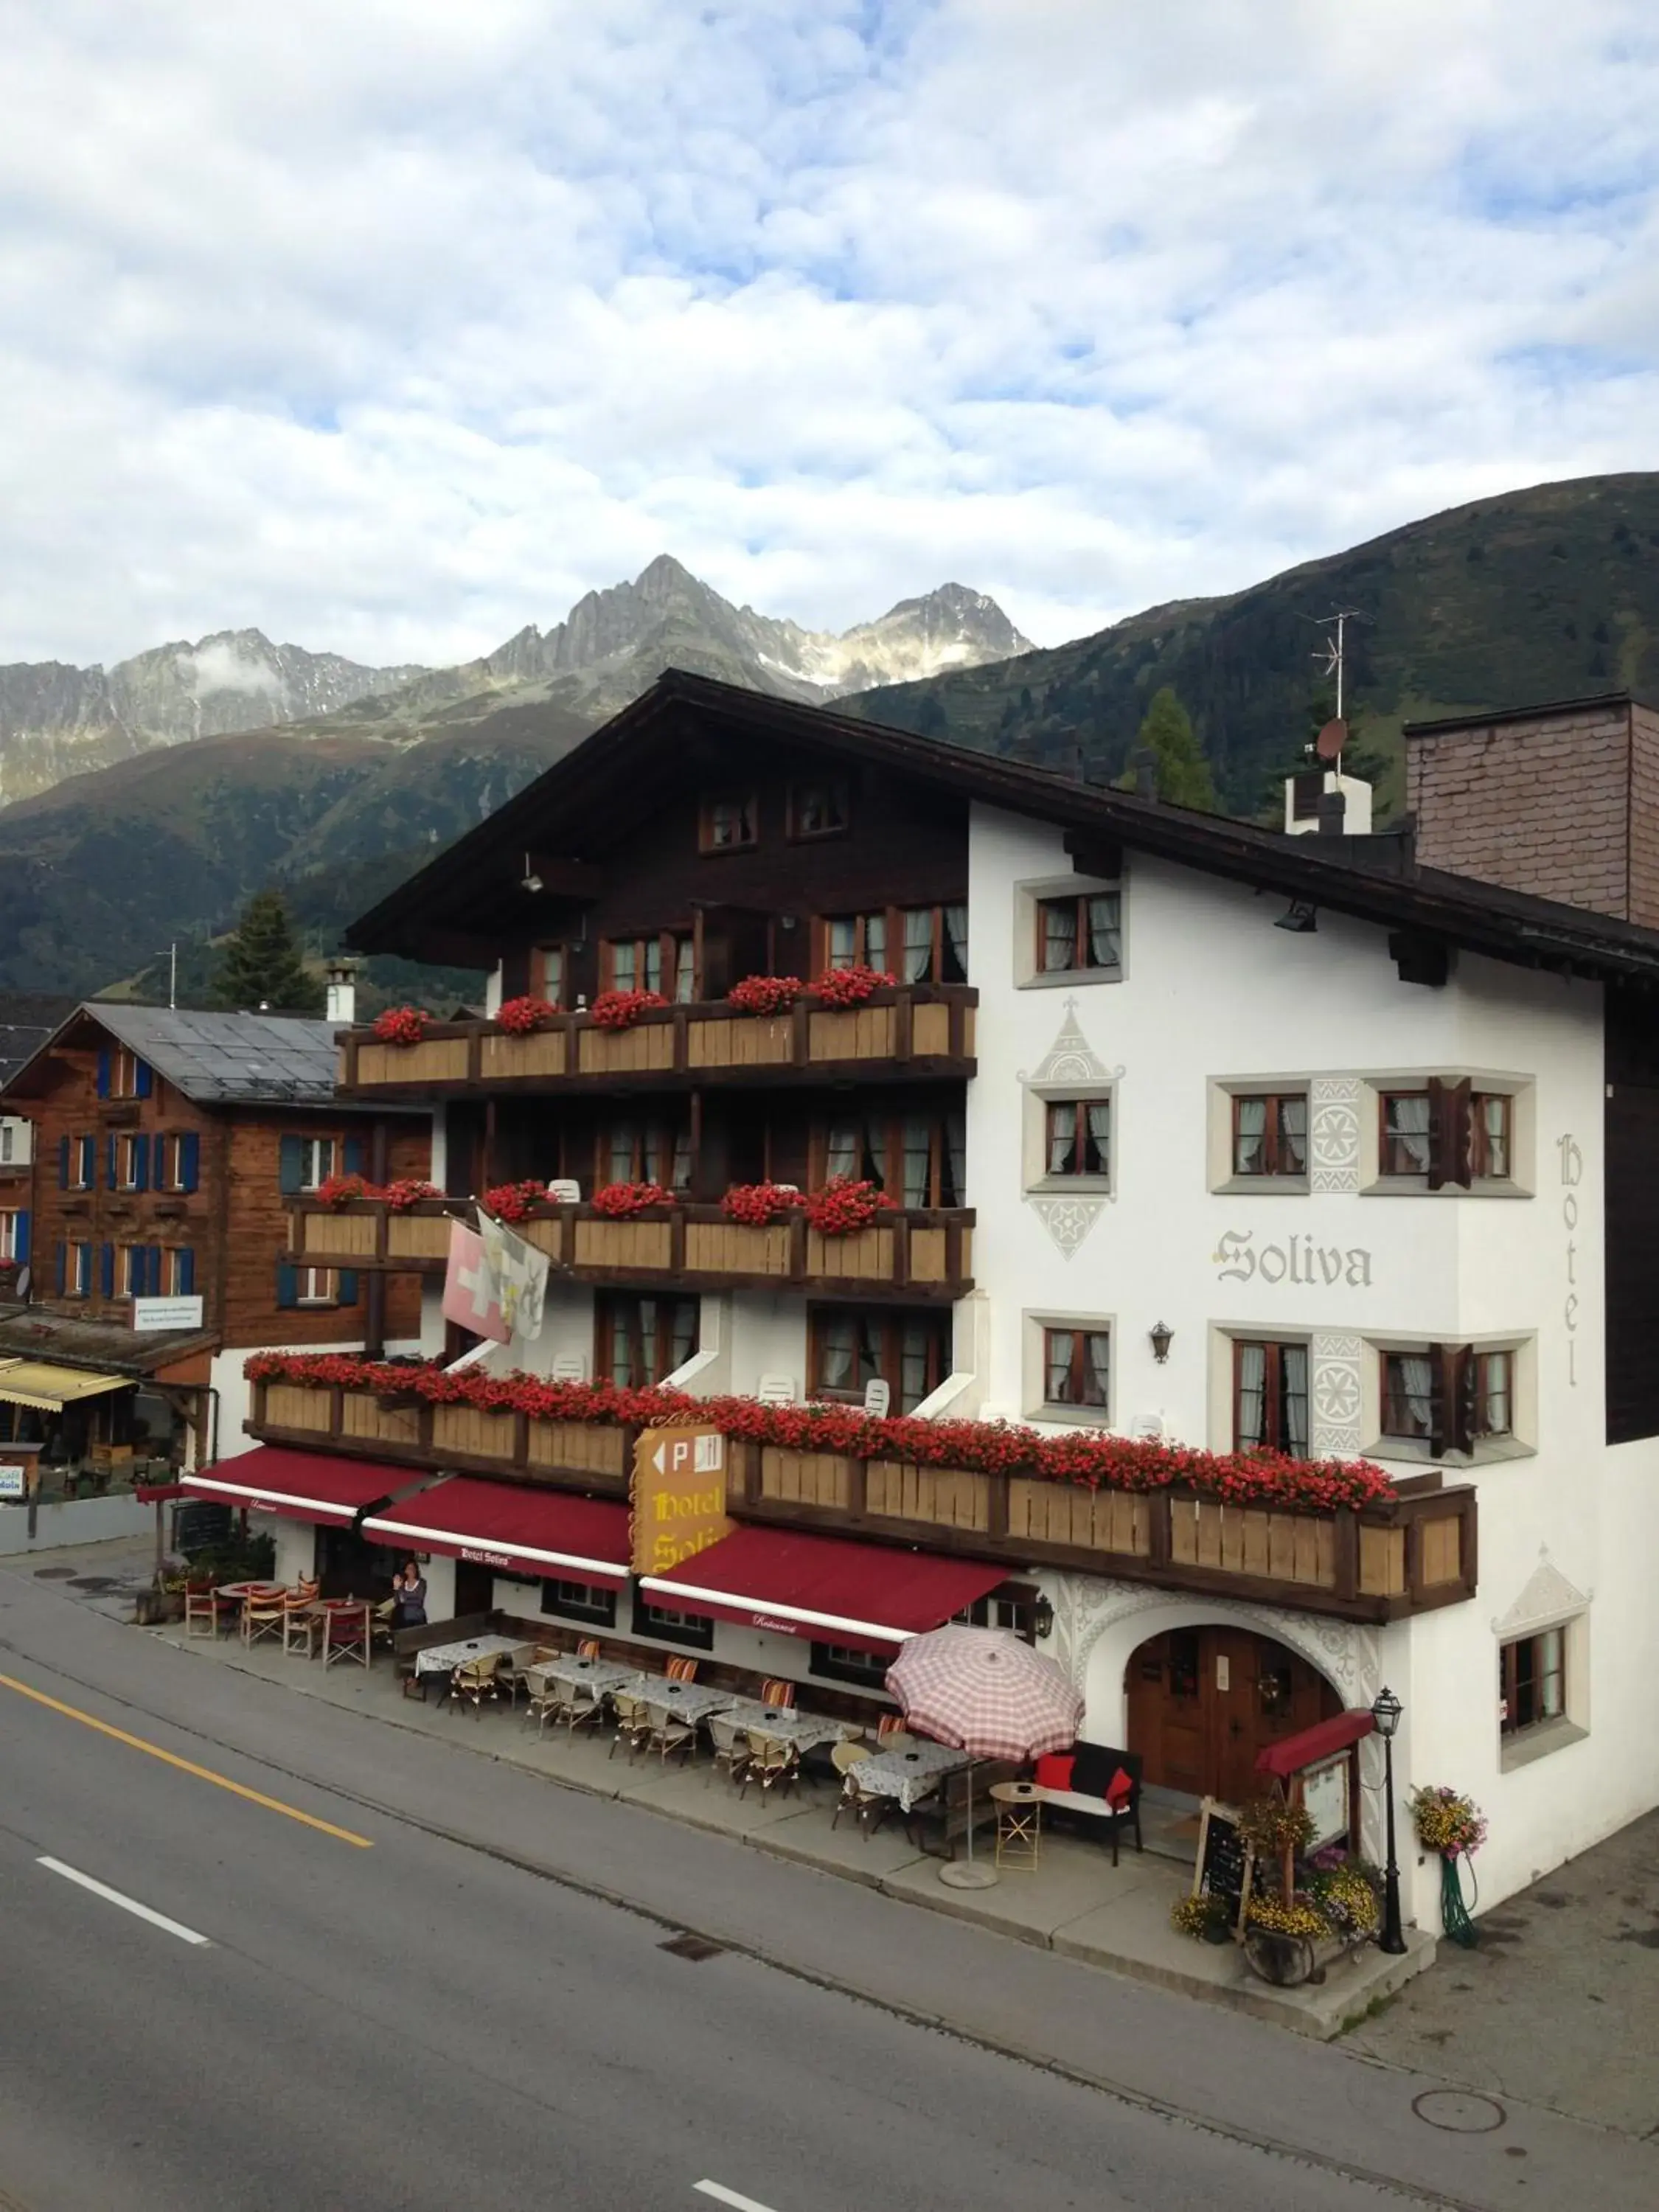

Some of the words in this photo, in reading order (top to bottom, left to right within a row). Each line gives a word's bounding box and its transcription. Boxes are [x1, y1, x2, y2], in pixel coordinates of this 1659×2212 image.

[1216, 1229, 1374, 1287] Soliva
[1557, 1133, 1583, 1388] Hotel
[672, 1441, 688, 1471] P
[653, 1486, 720, 1521] Hotel
[653, 1527, 726, 1573] Soli
